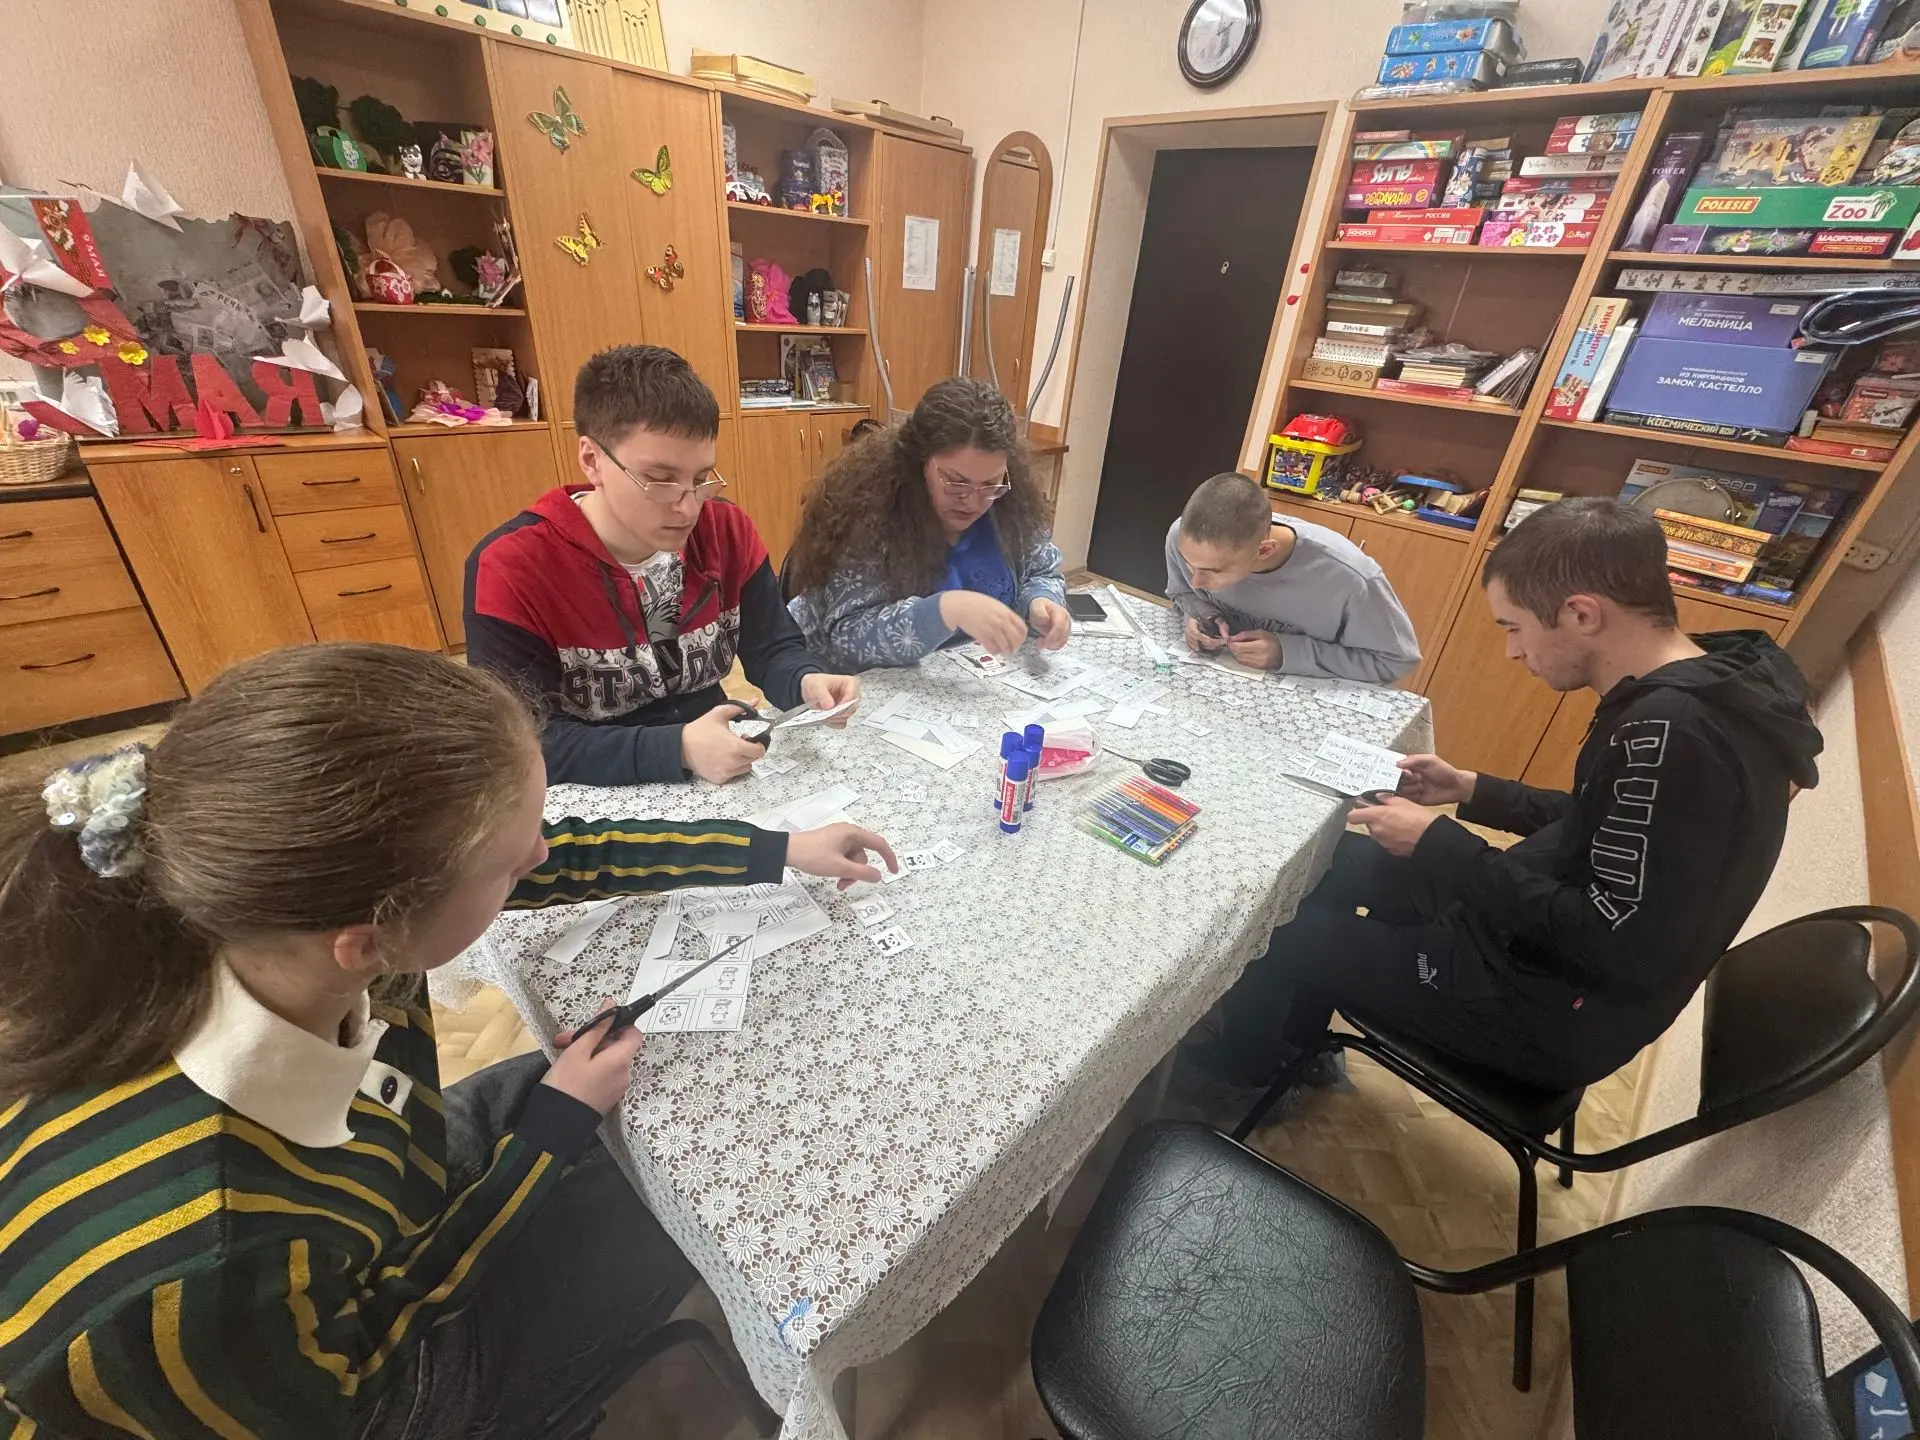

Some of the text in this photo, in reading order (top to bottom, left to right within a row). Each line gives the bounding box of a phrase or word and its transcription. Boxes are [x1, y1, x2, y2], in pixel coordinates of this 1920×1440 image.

[1755, 125, 1796, 135] CREATOR
[1369, 164, 1414, 183] ALIAS
[1652, 167, 1686, 176] TOWER
[1699, 199, 1752, 211] POLESIE
[1827, 204, 1868, 219] Zoo
[1347, 229, 1376, 237] MONOPOLY
[1817, 234, 1889, 244] MAGFORMERS
[84, 243, 107, 278] МАЯ
[1678, 316, 1754, 332] МЕЛЬНИЦА
[1583, 304, 1616, 367] РАЗВИВАЙКА
[1585, 323, 1599, 346] НАБОР
[1656, 376, 1764, 395] ЗАМОК КАСТЕЛЛО
[1679, 371, 1746, 384] ИЗ КИРПИЧИКОВ
[103, 351, 326, 435] МАЯ
[1646, 416, 1719, 434] КОСМИЧЕСКИЙ
[1718, 426, 1736, 436] БОЙ
[1417, 952, 1429, 985] PUMA
